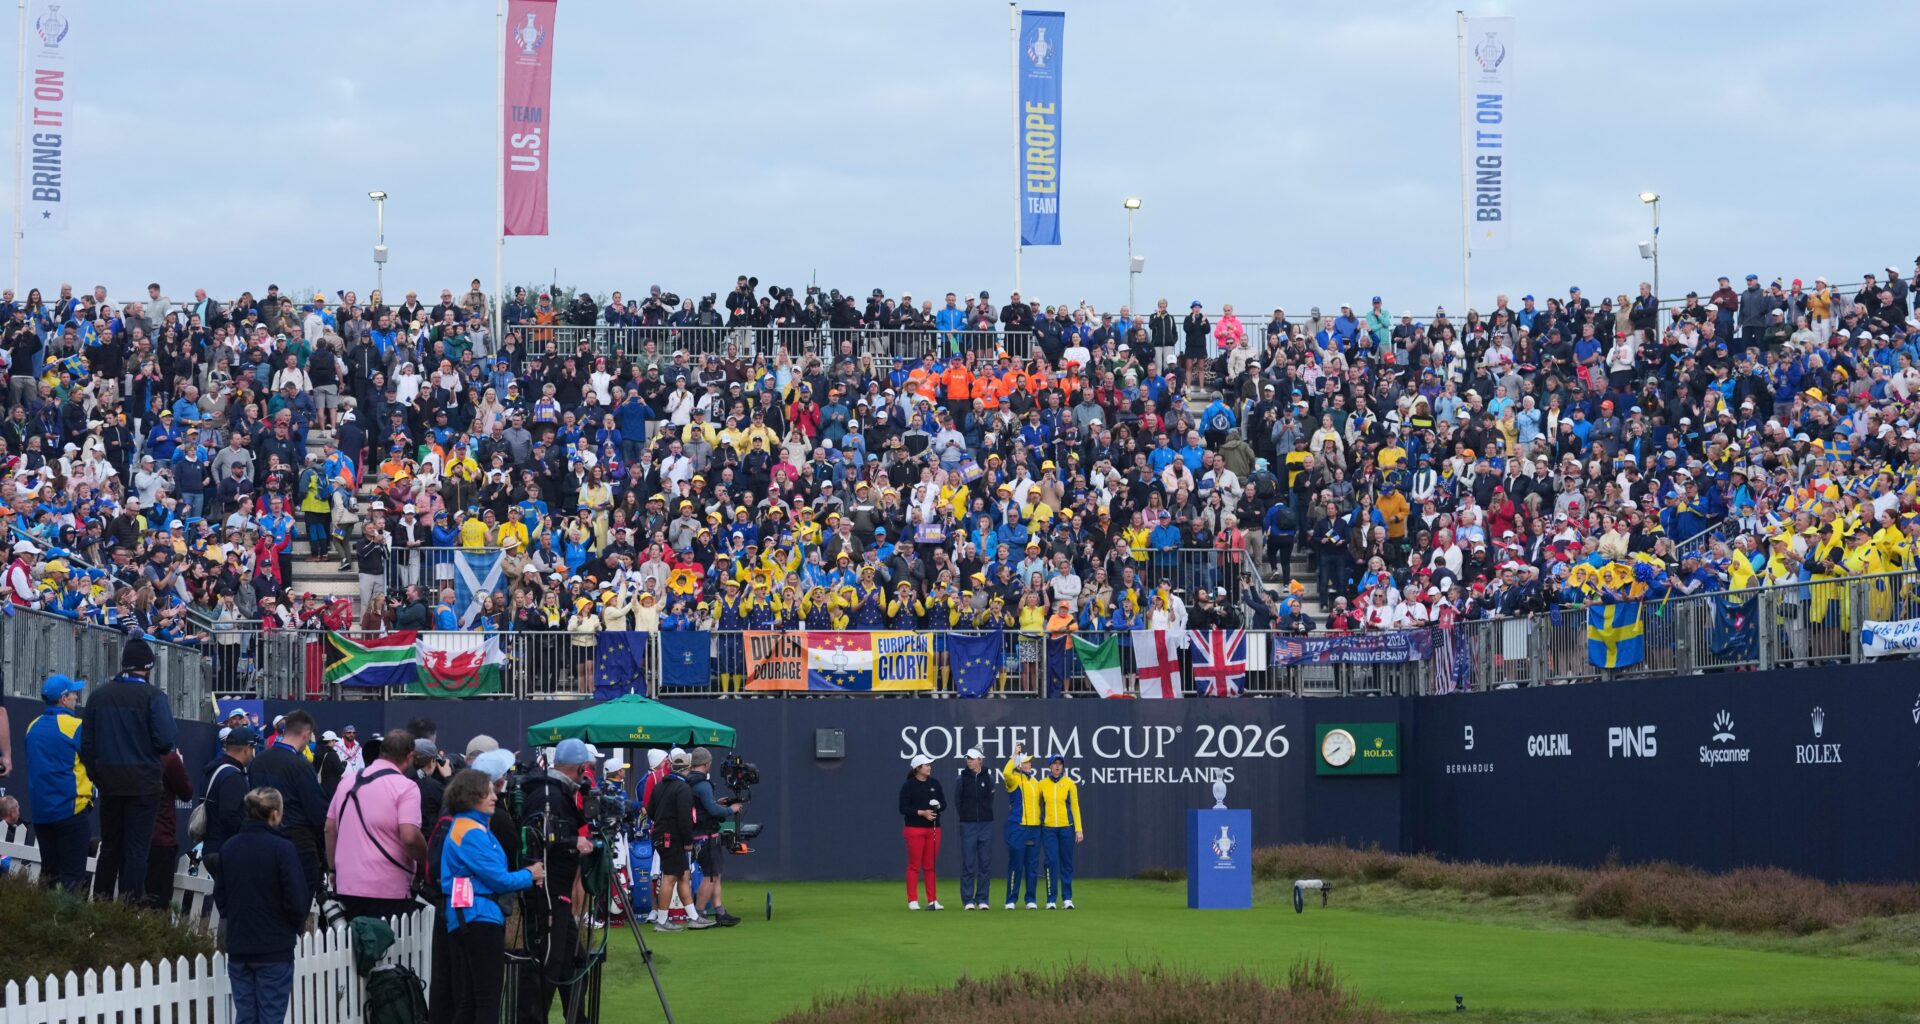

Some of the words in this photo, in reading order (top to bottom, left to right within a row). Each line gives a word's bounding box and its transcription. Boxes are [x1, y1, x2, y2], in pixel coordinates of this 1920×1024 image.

[34, 69, 65, 101] ON
[33, 107, 63, 126] IT
[512, 105, 542, 123] TEAM
[1476, 94, 1503, 124] ON
[511, 127, 541, 171] U.S.
[1025, 101, 1056, 193] EUROPE
[1476, 130, 1502, 148] IT
[32, 133, 62, 202] BRING
[1476, 155, 1502, 221] BRING
[1028, 197, 1057, 214] TEAM
[751, 634, 801, 660] DUTCH
[878, 635, 927, 654] EUROPEAN
[1386, 635, 1406, 647] 2026
[1341, 650, 1408, 662] ANNIVERSARY
[753, 661, 801, 680] COURAGE
[878, 655, 928, 680] GLORY!
[900, 725, 1083, 760] SOLHEIM
[1194, 724, 1290, 758] 2026
[1527, 733, 1571, 757] GOLF.NL
[1608, 725, 1657, 758] PING
[1363, 749, 1394, 757] ROLEX
[1699, 745, 1750, 767] Skyscanner
[1796, 743, 1842, 763] ROLEX
[1446, 763, 1494, 774] BERNARDUS
